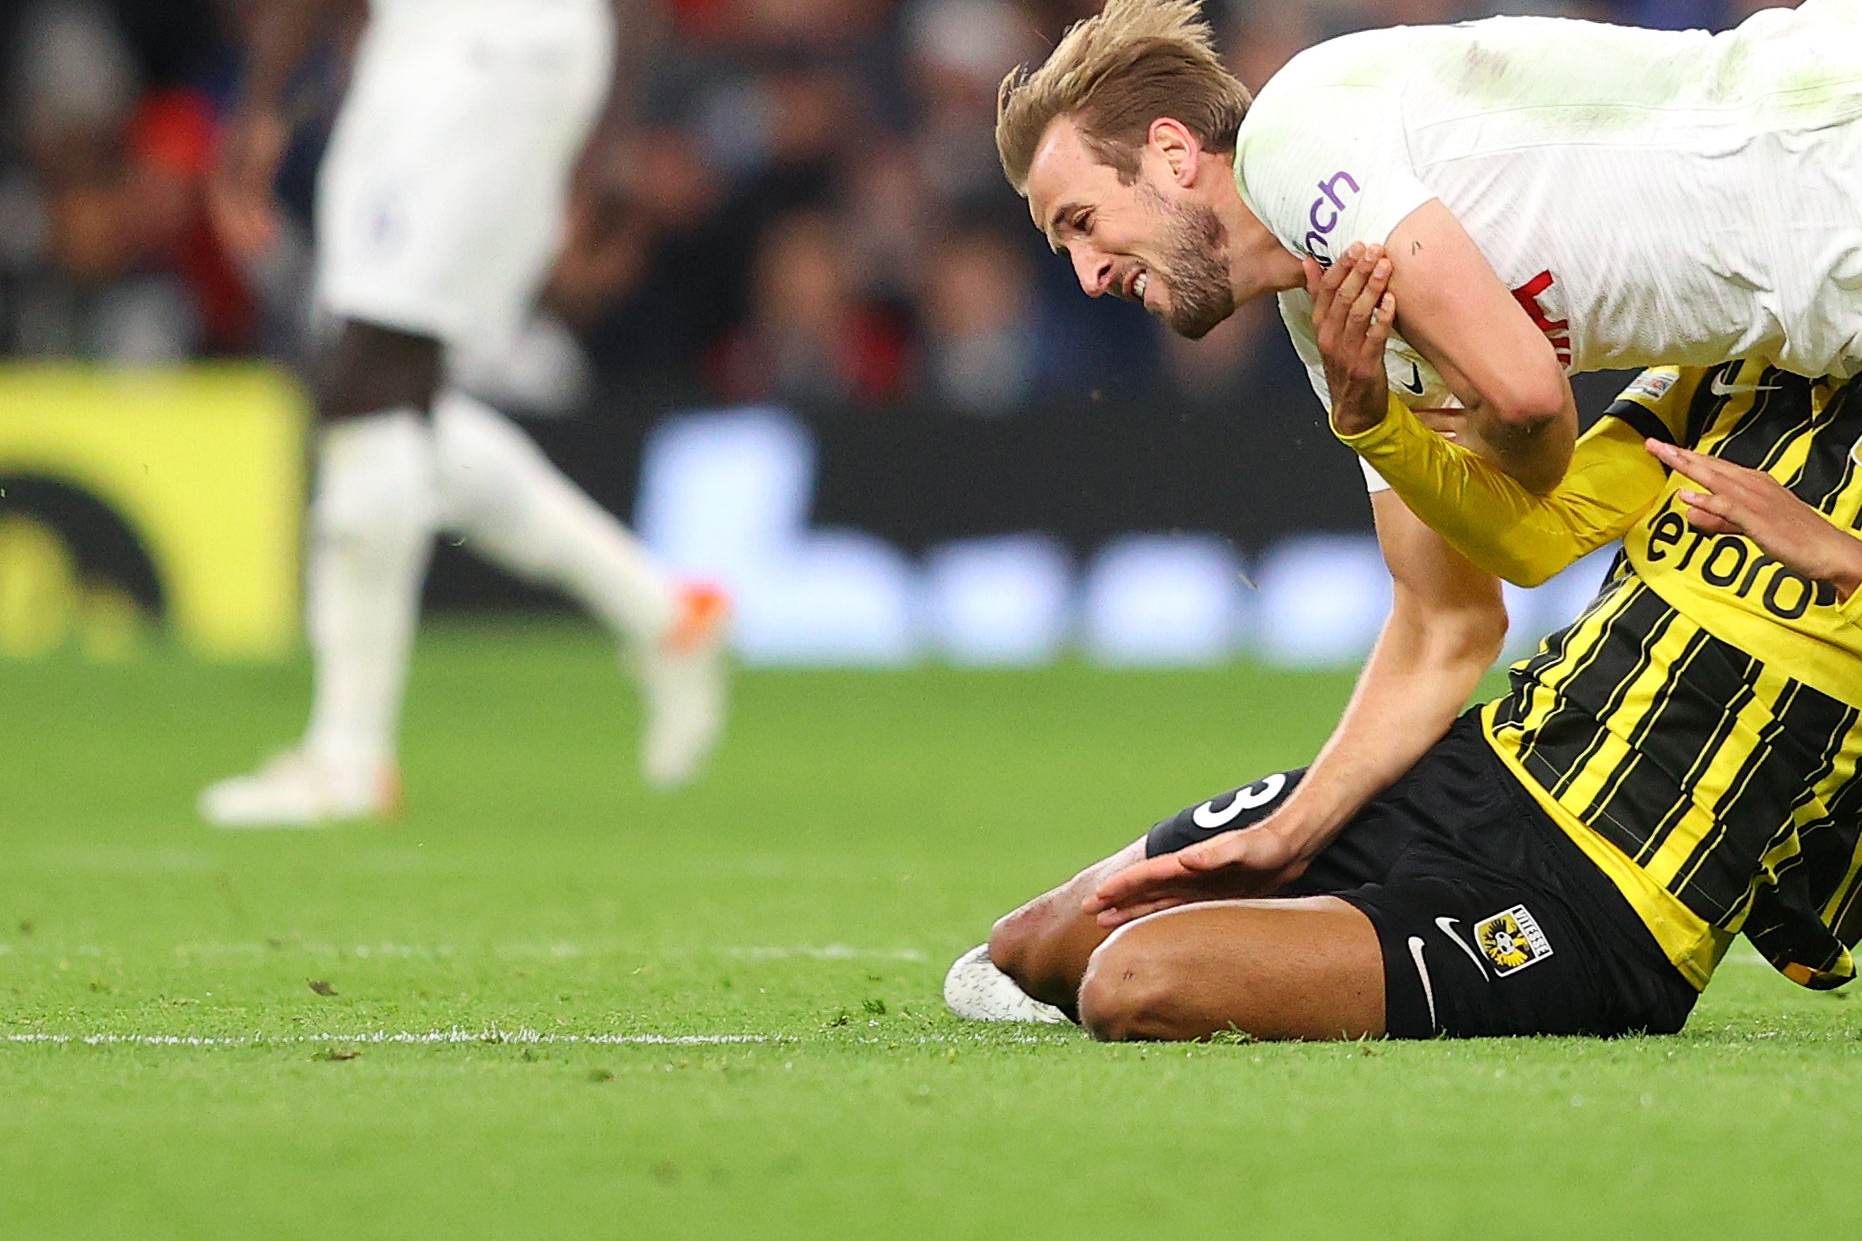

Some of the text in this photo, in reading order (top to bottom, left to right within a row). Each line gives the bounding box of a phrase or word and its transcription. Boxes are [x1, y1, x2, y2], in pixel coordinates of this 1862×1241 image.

[1307, 170, 1361, 268] nch
[1192, 773, 1287, 829] 3
[1514, 907, 1551, 956] VITESSE
